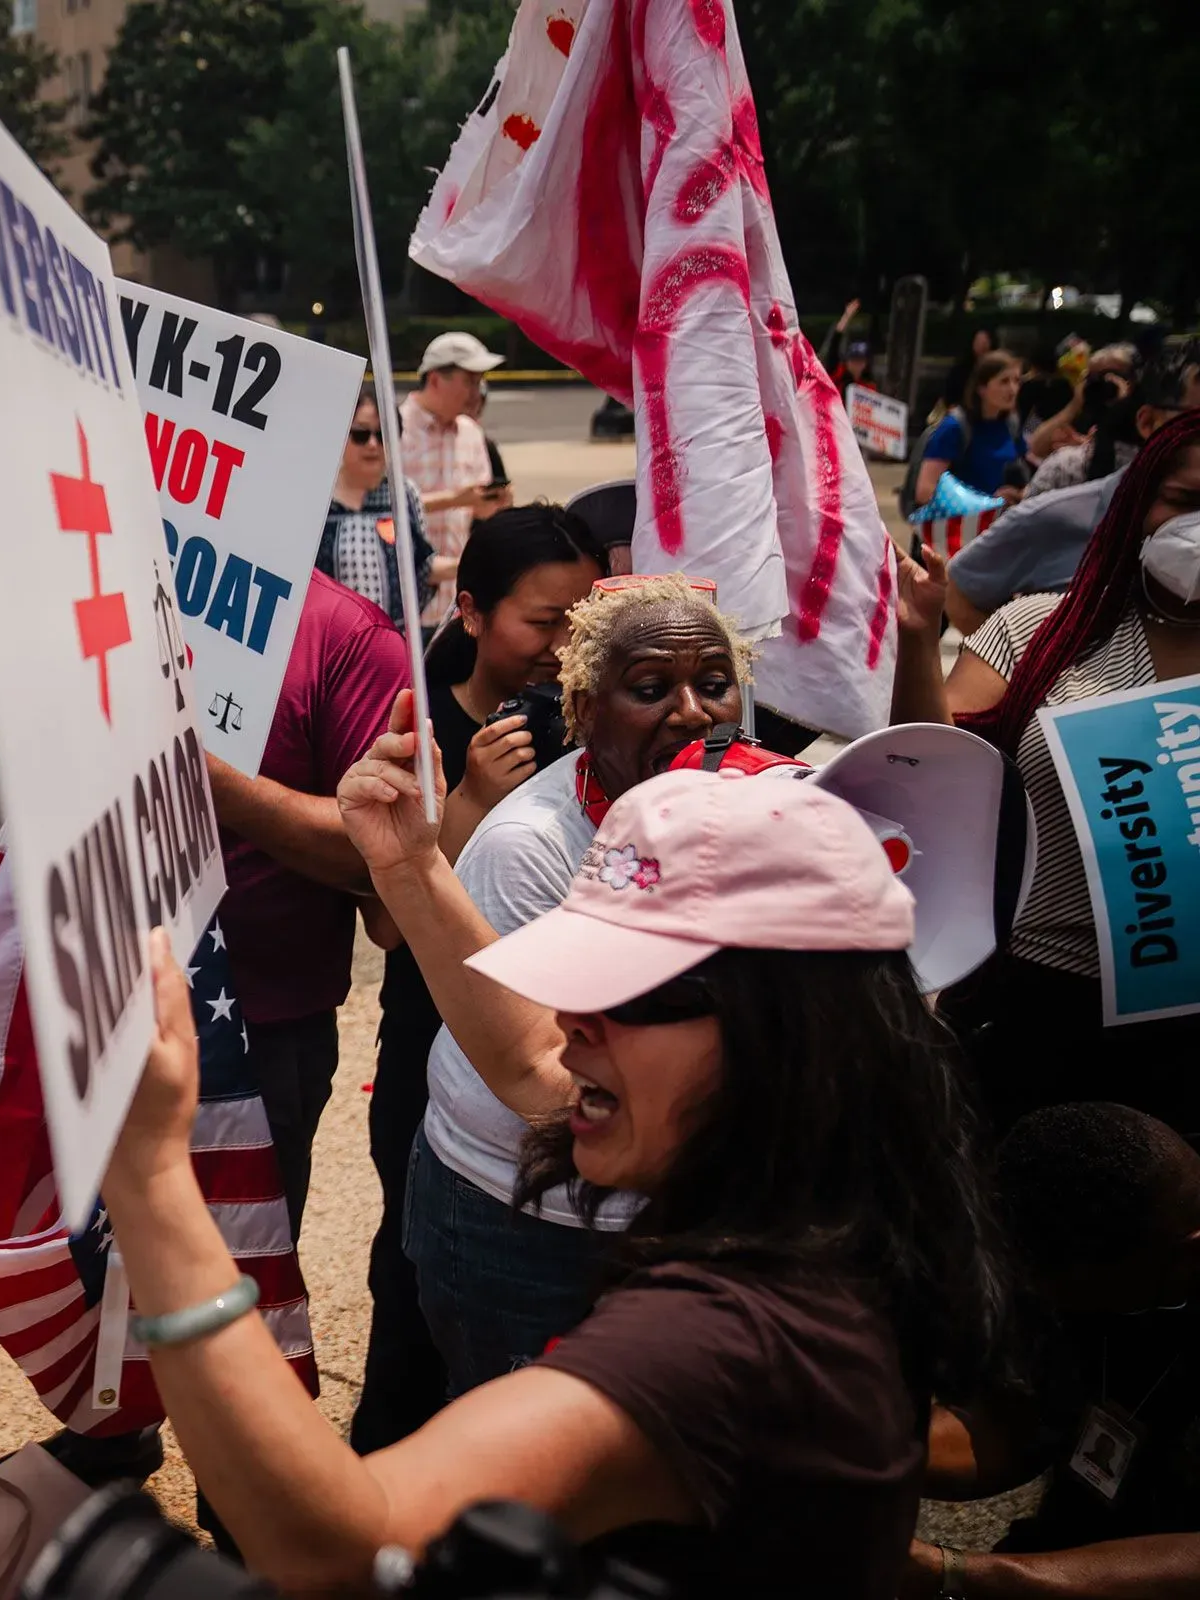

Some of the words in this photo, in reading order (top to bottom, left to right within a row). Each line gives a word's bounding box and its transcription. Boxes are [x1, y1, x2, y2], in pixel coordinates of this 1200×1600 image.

[149, 310, 282, 432] K-12
[163, 518, 293, 656] OAT
[46, 797, 144, 1101] SKIN
[132, 725, 216, 930] COLOR
[1098, 756, 1179, 968] Diversity
